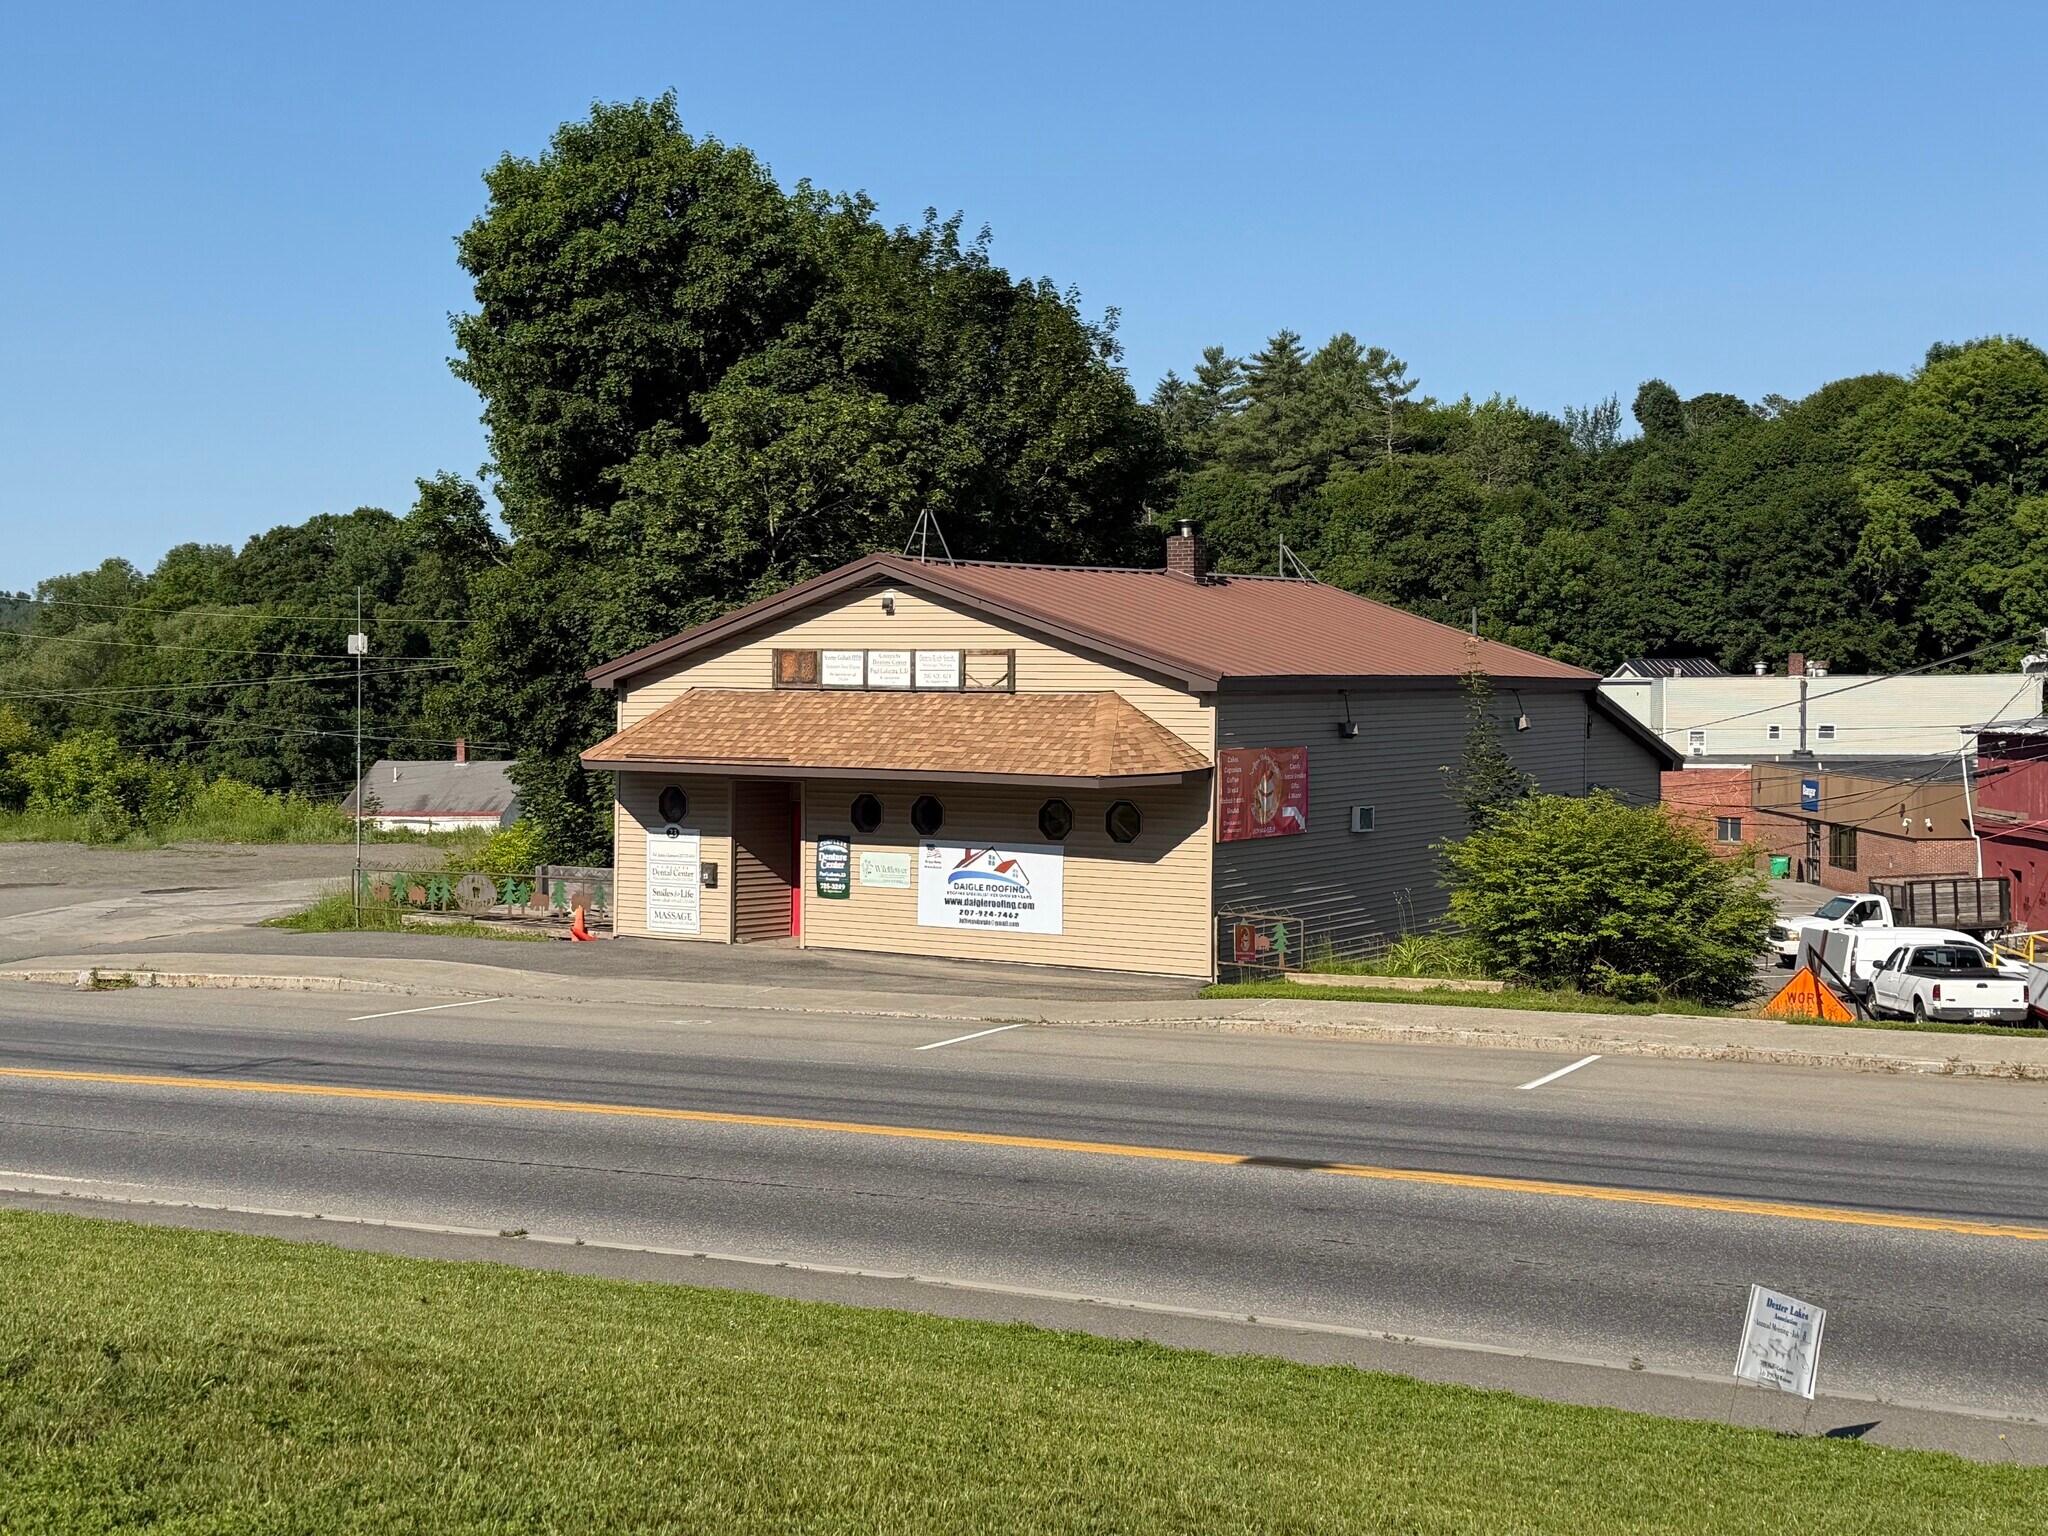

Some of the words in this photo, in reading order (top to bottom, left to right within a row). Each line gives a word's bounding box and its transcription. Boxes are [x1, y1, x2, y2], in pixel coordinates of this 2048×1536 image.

[819, 852, 847, 861] Denture
[821, 861, 845, 869] Center
[673, 868, 694, 877] Center
[681, 889, 694, 898] Life
[954, 883, 984, 891] DAIGLE
[986, 884, 1025, 894] ROOFING
[944, 897, 1035, 910] www.daigleroofing.com
[654, 910, 692, 921] MASSAGE
[959, 909, 1019, 919] 207-924-7462
[1766, 1297, 1789, 1313] Dexter
[1790, 1305, 1809, 1320] Lakes
[1756, 1318, 1771, 1330] Annual
[1772, 1323, 1789, 1336] Meeting
